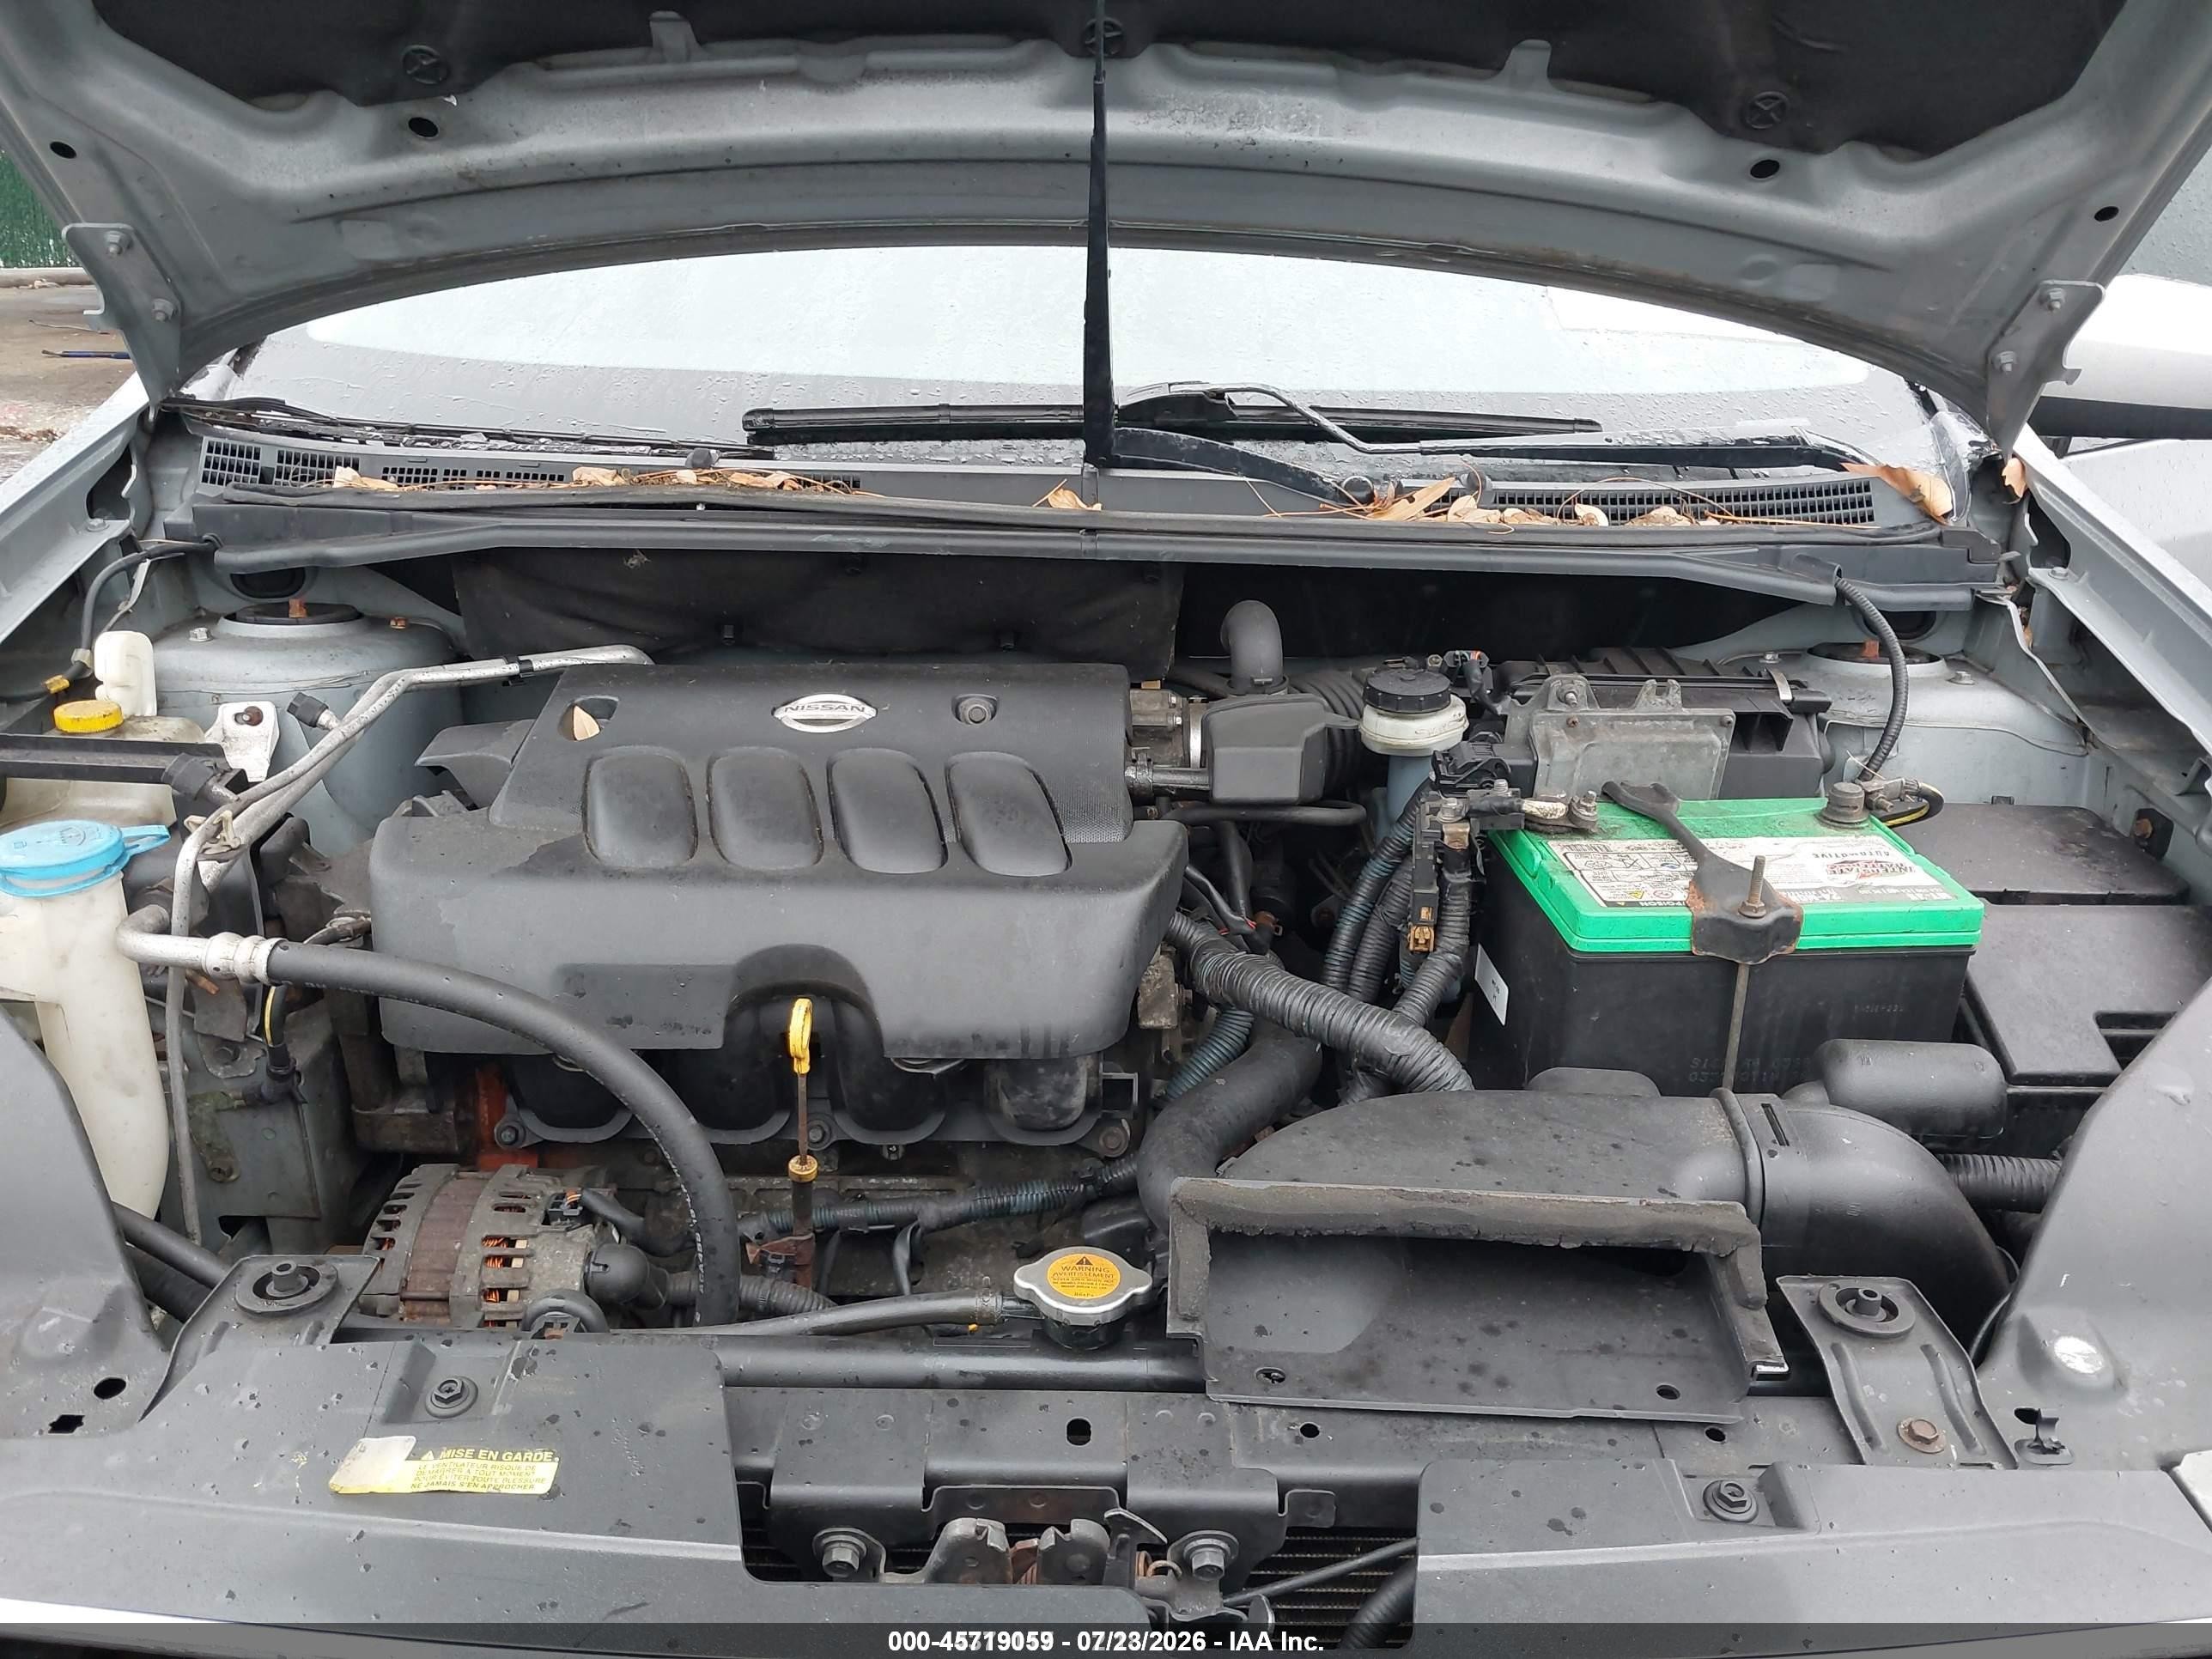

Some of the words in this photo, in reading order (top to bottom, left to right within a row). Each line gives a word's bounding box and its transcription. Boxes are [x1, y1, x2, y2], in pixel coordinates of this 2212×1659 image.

[784, 703, 866, 713] NISSAN
[1826, 866, 1916, 875] INTERSTATE
[439, 1449, 476, 1460] MISE
[477, 1449, 498, 1461] EN
[432, 1462, 488, 1470] VENTILATEUR
